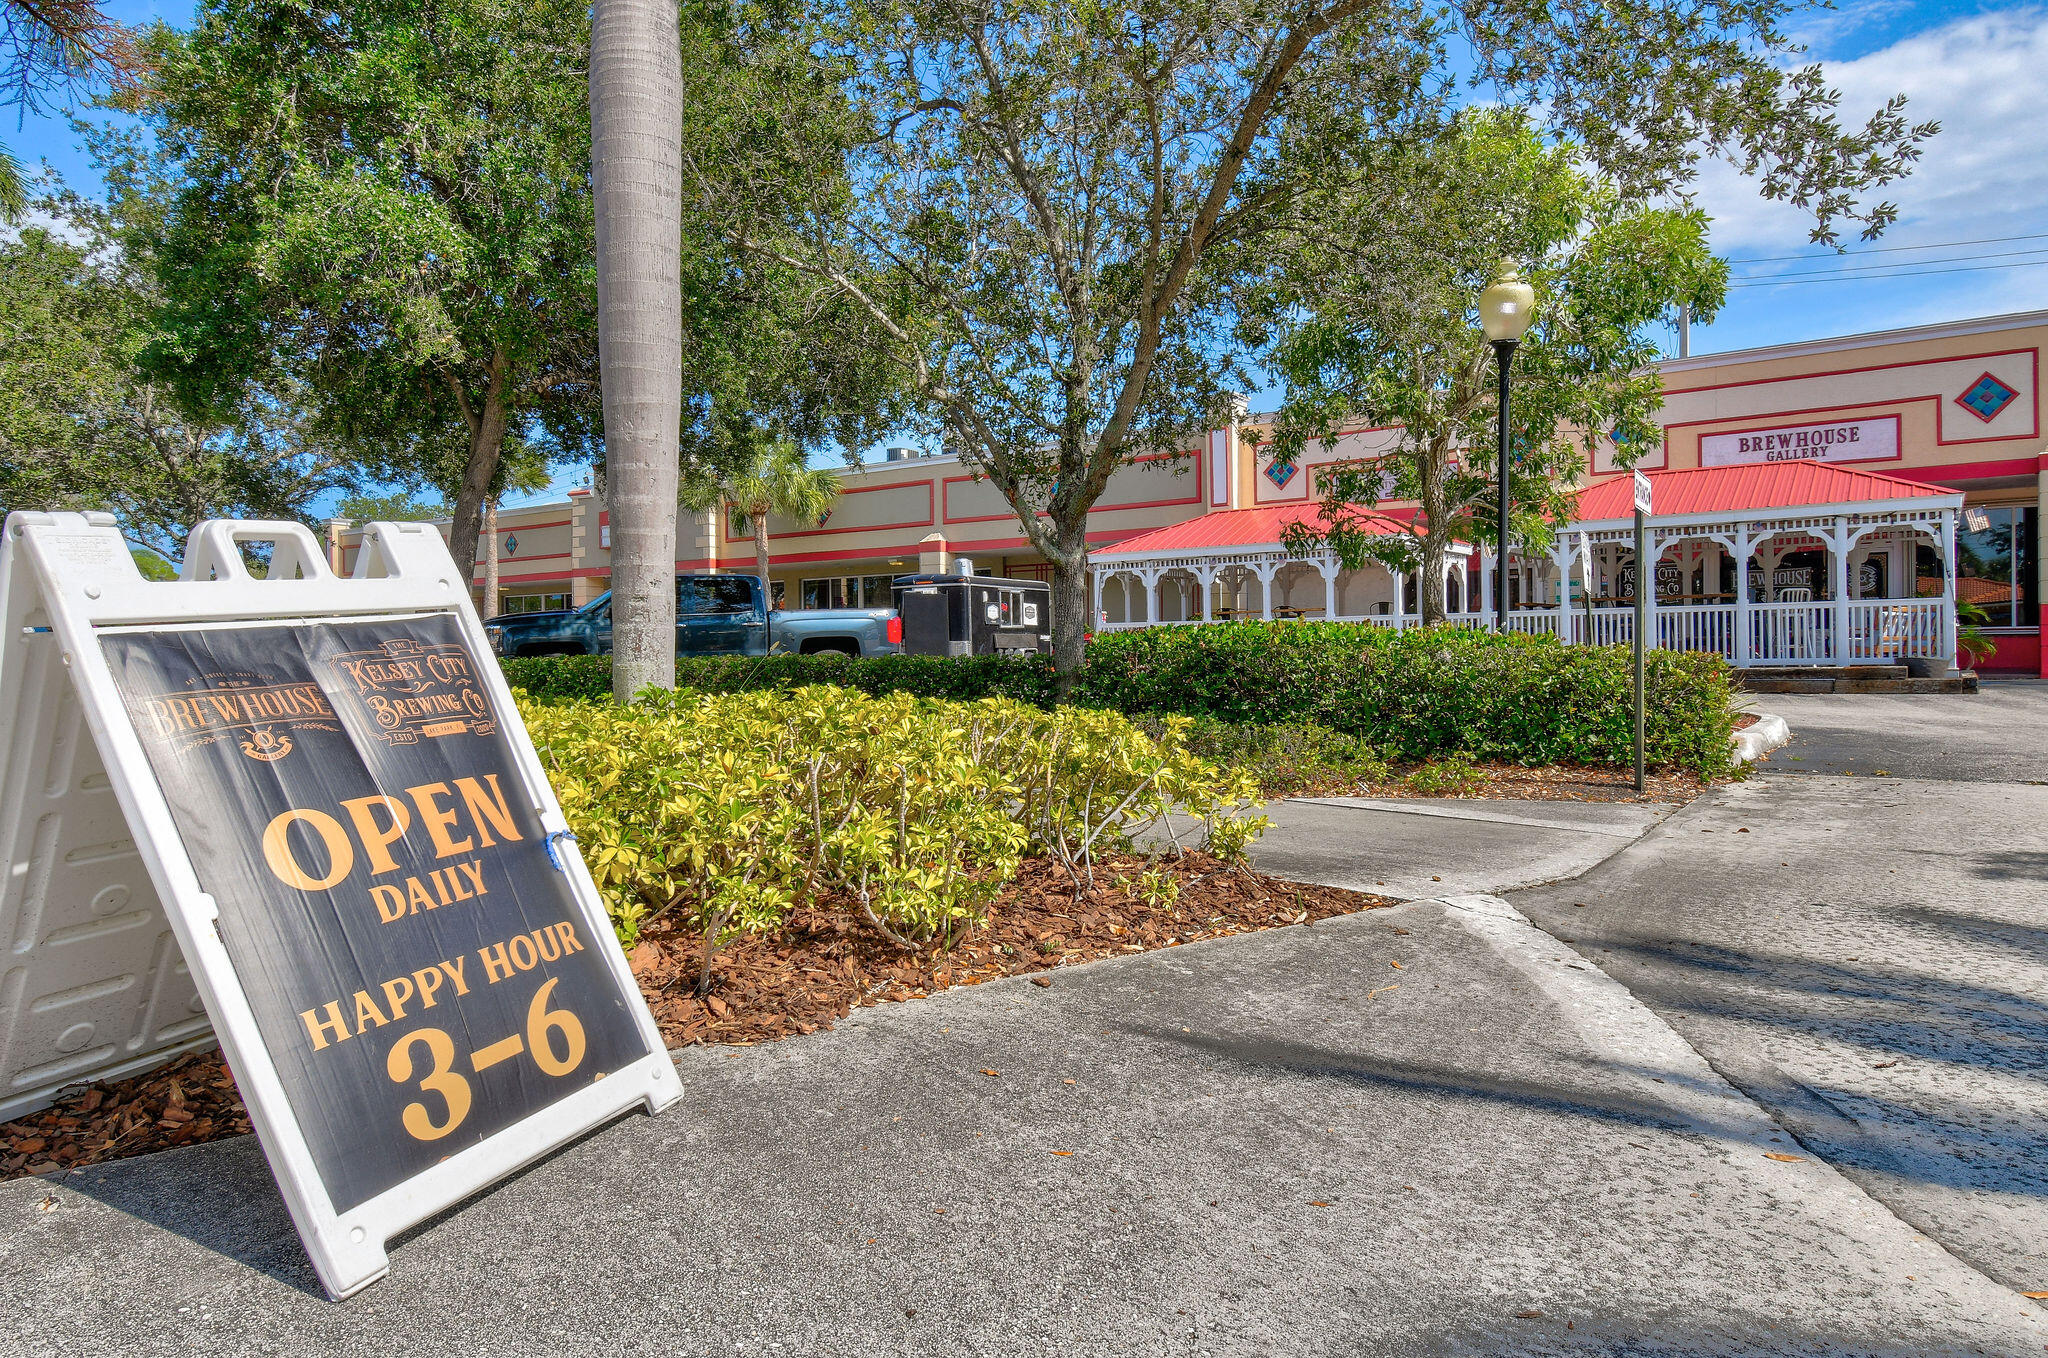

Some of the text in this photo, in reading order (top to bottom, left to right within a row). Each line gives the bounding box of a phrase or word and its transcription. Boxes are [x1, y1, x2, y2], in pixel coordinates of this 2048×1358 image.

[1738, 426, 1860, 453] BREWHOUSE
[1766, 446, 1830, 462] GALLERY
[341, 655, 470, 696] KELSEY CITY
[149, 685, 333, 738] BREWHOUSE
[366, 693, 463, 730] BREWING
[262, 773, 524, 891] OPEN
[368, 859, 489, 924] DAILY
[299, 920, 584, 1052] HAPPY HOUR
